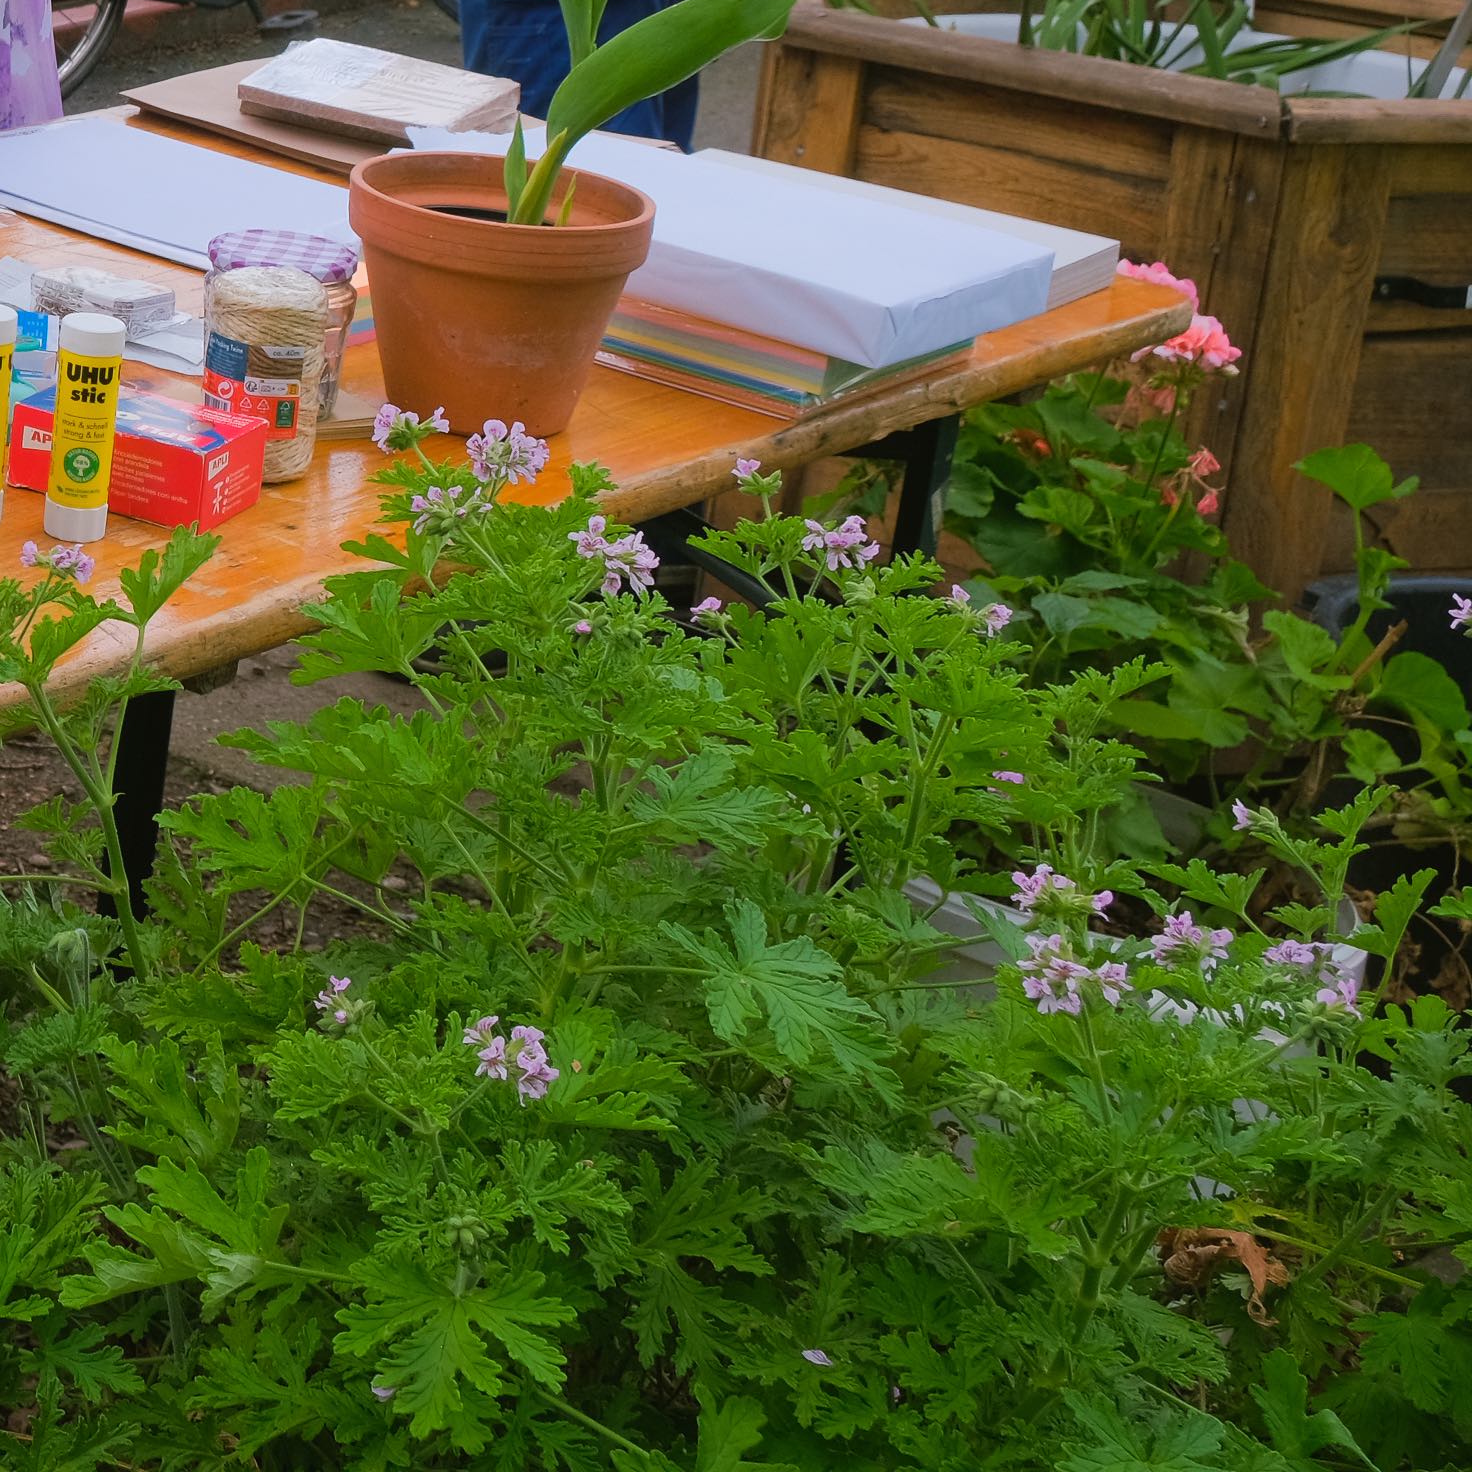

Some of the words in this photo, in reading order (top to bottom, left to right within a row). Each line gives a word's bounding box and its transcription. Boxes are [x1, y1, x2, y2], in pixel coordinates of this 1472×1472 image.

[67, 362, 114, 385] UHU
[71, 387, 106, 404] stic
[63, 429, 84, 439] strong
[85, 431, 92, 439] &
